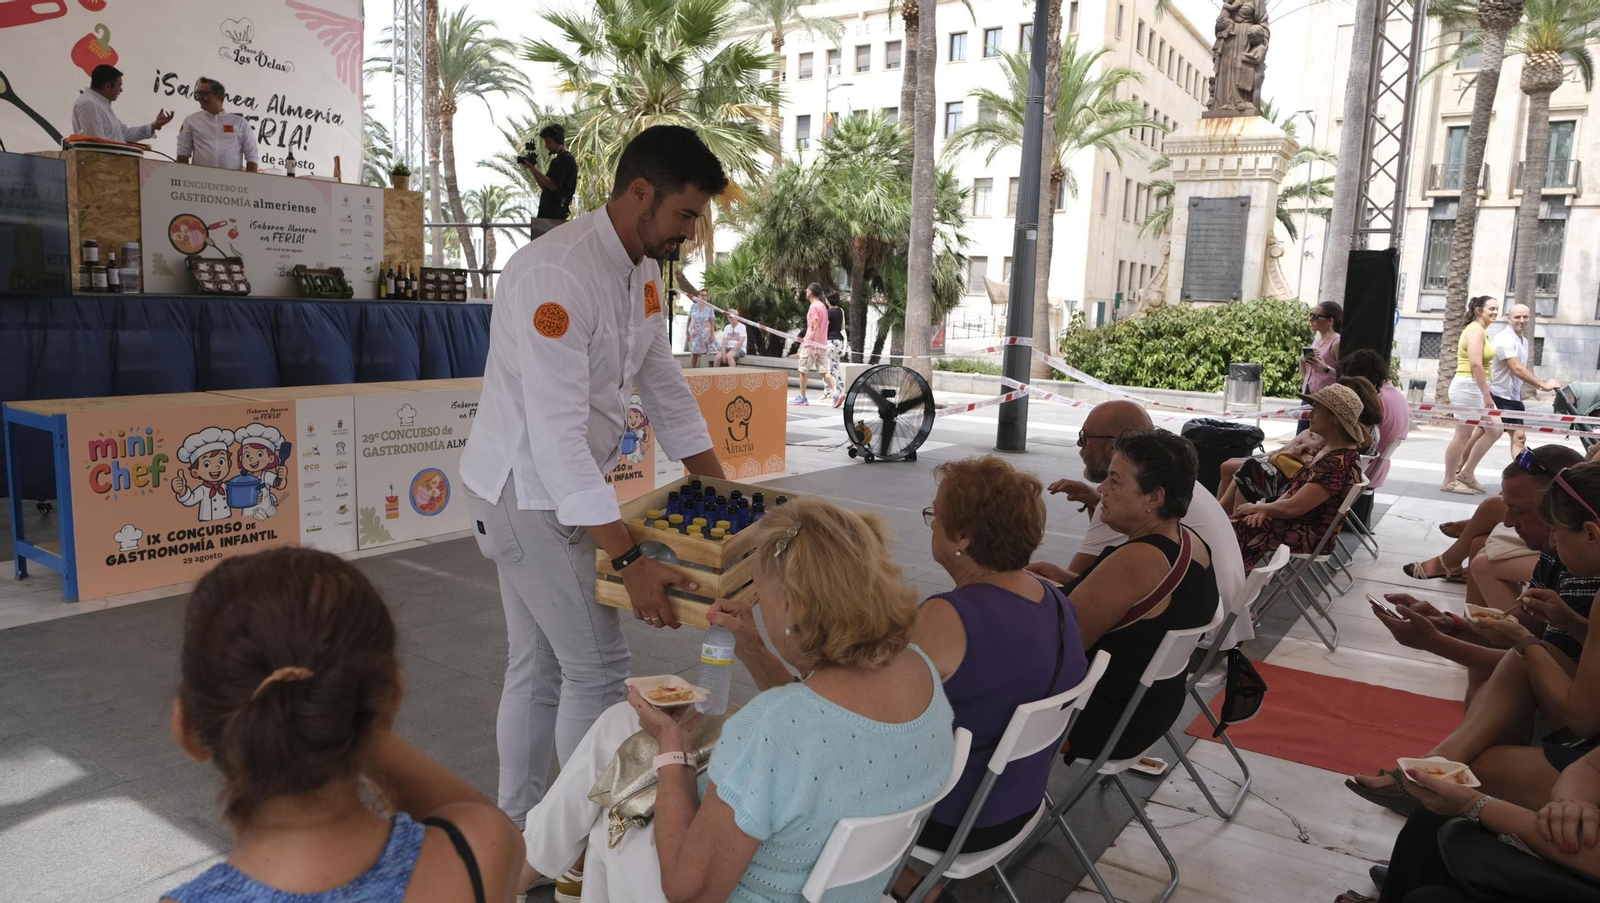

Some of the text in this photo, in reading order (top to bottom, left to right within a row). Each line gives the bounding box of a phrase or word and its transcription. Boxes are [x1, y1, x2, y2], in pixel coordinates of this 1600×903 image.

[855, 24, 872, 36] DE
[233, 49, 251, 65] Las
[266, 92, 344, 126] Almería
[261, 152, 276, 165] de
[170, 178, 249, 194] III ENCUENTRO DE
[170, 191, 317, 214] GASTRONOMÍA almeriense
[272, 232, 305, 244] FERIA!
[381, 426, 441, 441] CONCURSO
[441, 425, 453, 435] de
[88, 427, 154, 462] mini
[362, 438, 445, 458] GASTRONOMÍA
[721, 438, 754, 455] Almería
[304, 463, 320, 471] eco
[614, 471, 643, 482] INFANTIL
[146, 521, 256, 546] IX CONCURSO DE
[105, 529, 278, 567] GASTRONOMÍA INFANTIL
[182, 552, 223, 565] 29 agosto
